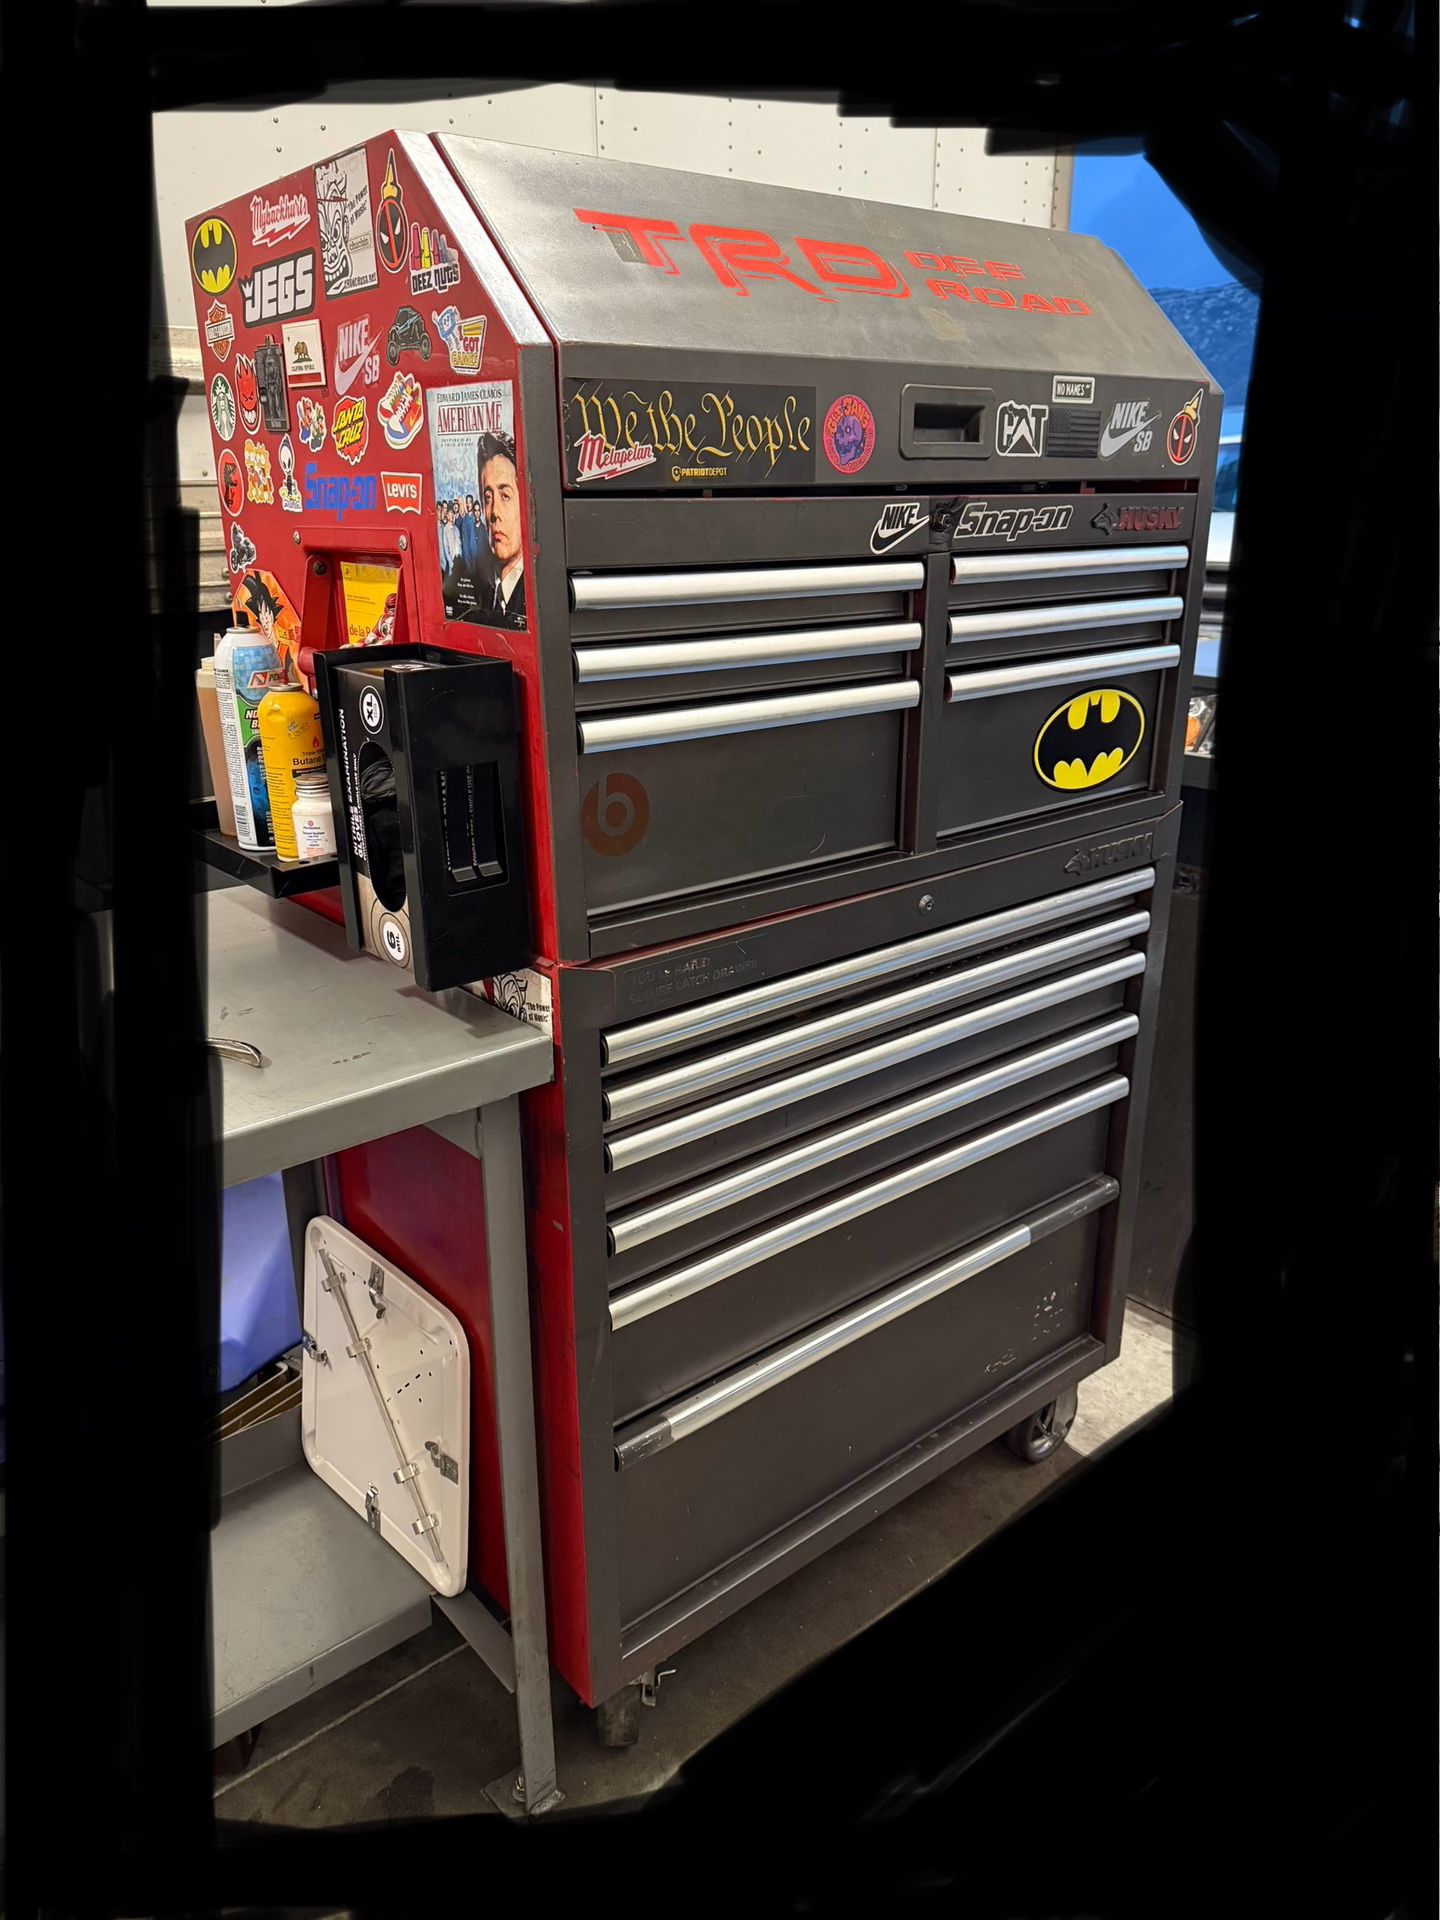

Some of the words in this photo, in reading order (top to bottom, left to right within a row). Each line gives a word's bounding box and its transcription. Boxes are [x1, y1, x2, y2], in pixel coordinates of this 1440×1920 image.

[574, 209, 912, 302] TRD
[903, 249, 1025, 281] OFF
[243, 254, 313, 323] JEGS
[412, 271, 432, 293] DEEZ
[923, 279, 1093, 316] ROAD
[339, 318, 369, 361] NIKE
[458, 325, 463, 341] I
[463, 336, 480, 352] GOT
[365, 355, 380, 385] SB
[437, 393, 460, 404] EDWARD
[461, 391, 479, 402] JAMES
[480, 389, 502, 400] OLMOS
[1057, 383, 1066, 396] NO
[333, 402, 363, 432] SANTA
[437, 404, 484, 433] AMERICAN
[485, 401, 502, 431] ME
[570, 383, 641, 451] We
[645, 390, 702, 458] the
[696, 390, 811, 478] People
[1110, 401, 1149, 430] NIKE
[338, 421, 364, 450] CRUZ
[1134, 430, 1153, 452] SB
[305, 463, 376, 522] Snap-on
[880, 504, 919, 531] NIKE
[954, 502, 1074, 541] Snap-on
[1117, 506, 1184, 530] HUSKY
[366, 695, 374, 723] XL
[293, 757, 321, 766] Butane
[338, 708, 353, 803] EXAMINATION
[348, 805, 359, 856] NITRILE
[353, 806, 363, 859] GLOVES
[386, 930, 397, 950] 6
